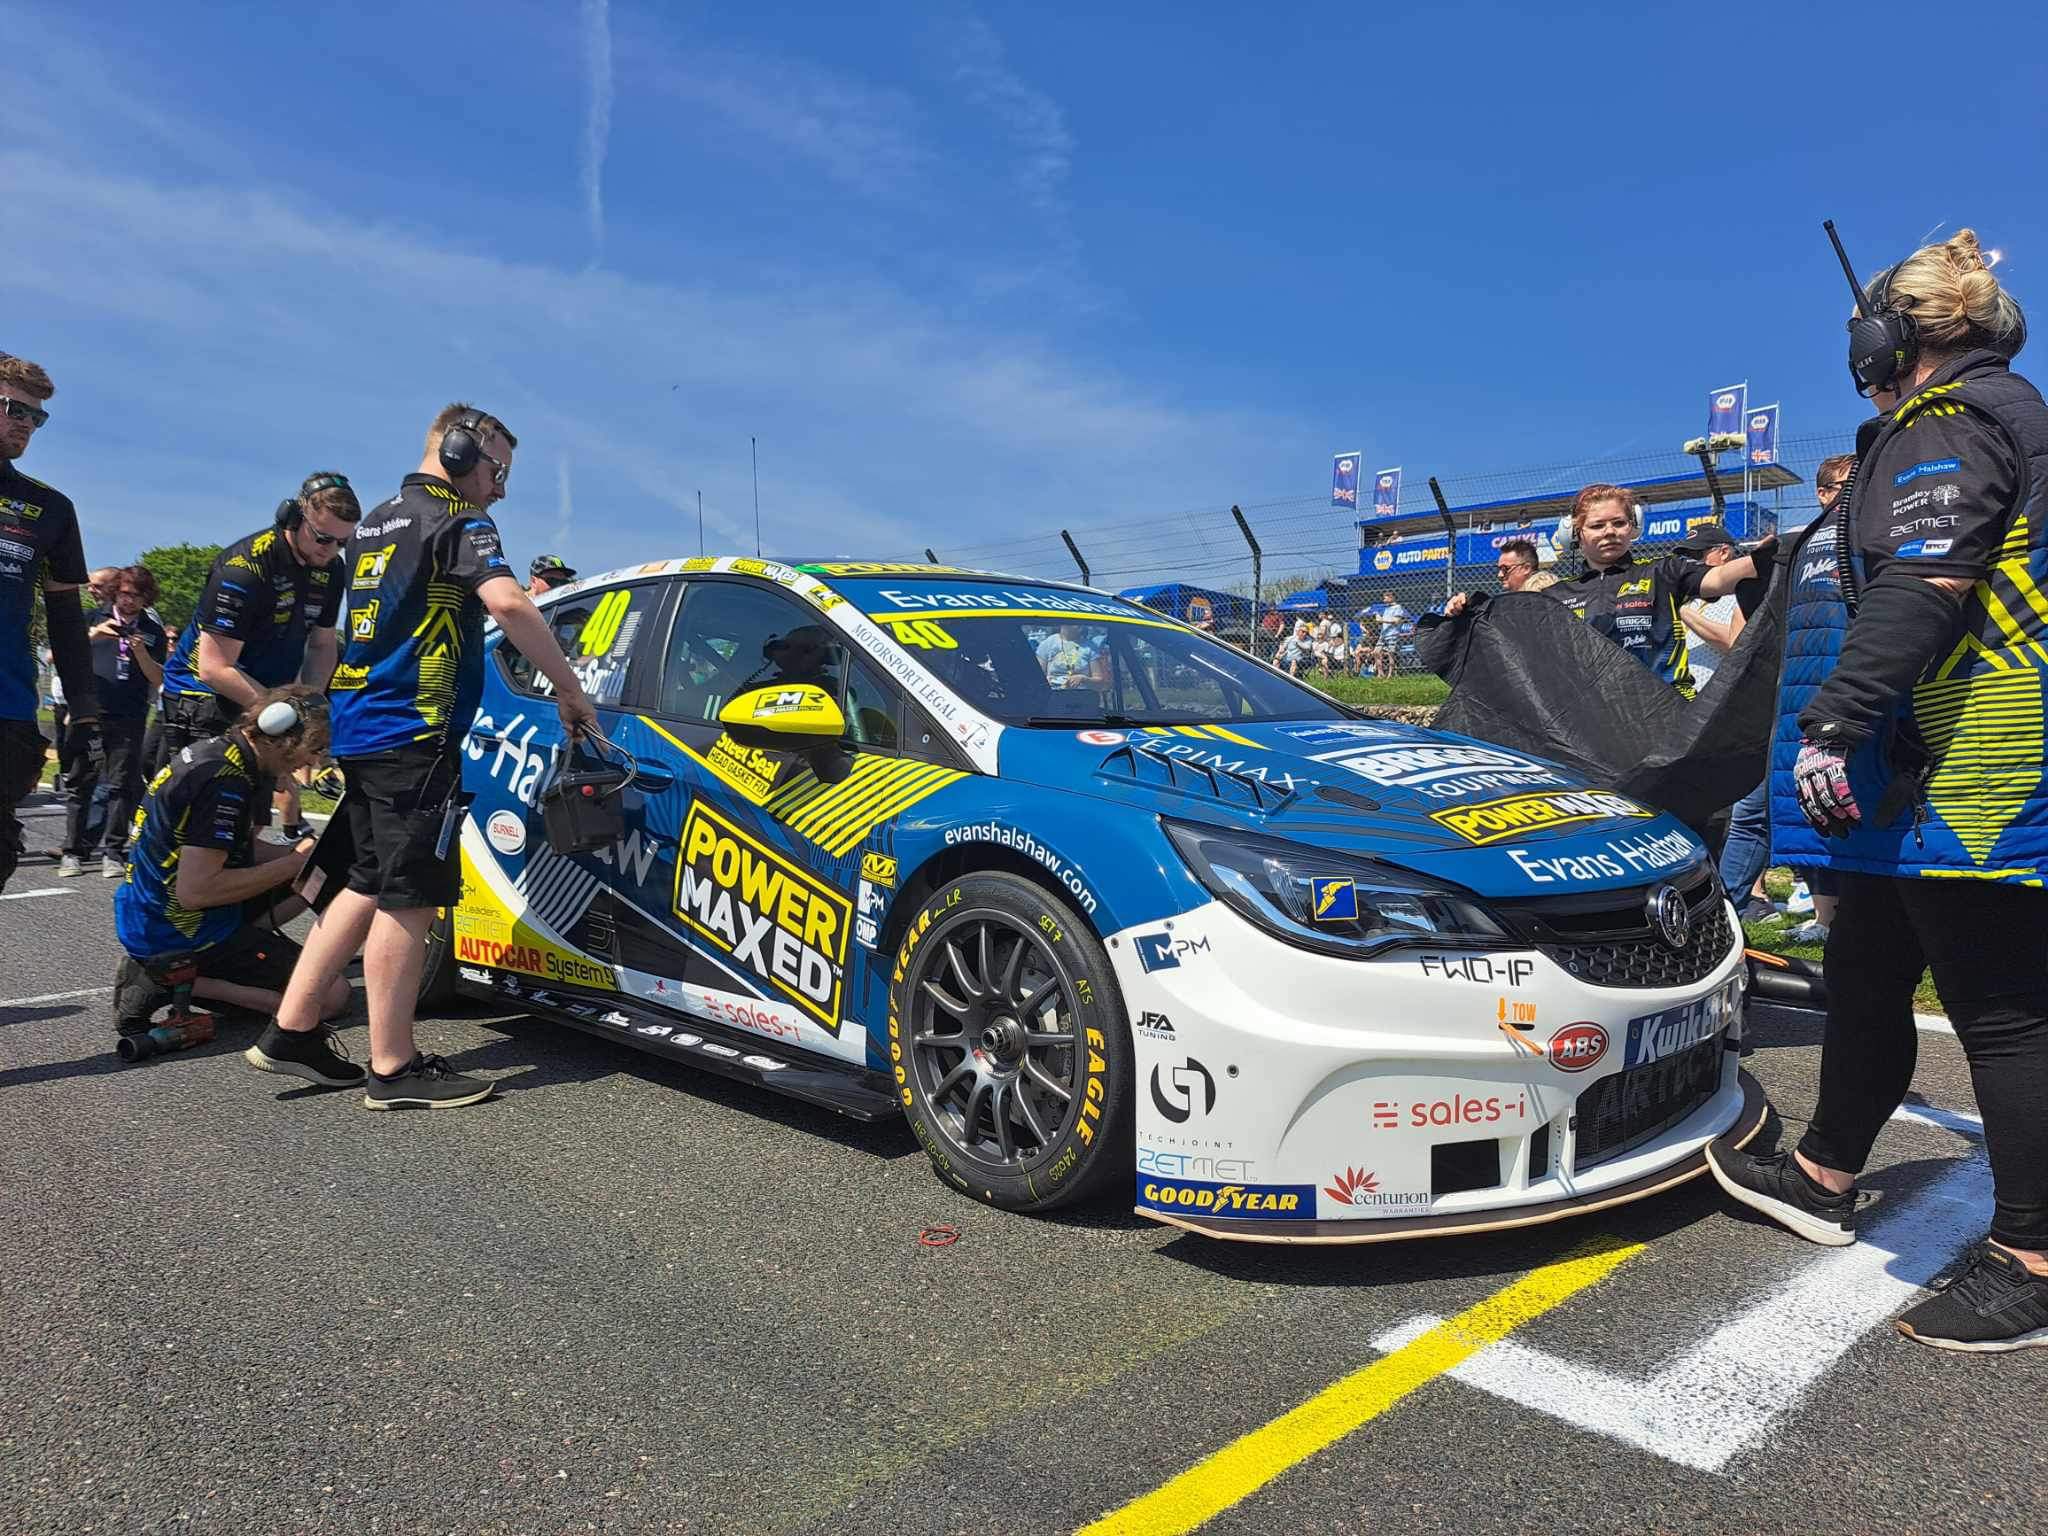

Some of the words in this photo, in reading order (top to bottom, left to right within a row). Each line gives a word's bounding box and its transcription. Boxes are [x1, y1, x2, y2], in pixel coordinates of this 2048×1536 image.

[1893, 490, 1931, 508] Bramley
[1893, 499, 1928, 516] POWER
[1648, 519, 1681, 536] AUTO
[1890, 515, 1959, 537] ZETMET
[1396, 550, 1422, 565] AUTO
[878, 590, 1009, 608] Evans
[1002, 592, 1145, 619] Halshaw
[579, 588, 631, 656] 40
[891, 619, 959, 649] 40
[852, 623, 924, 688] MOTORSPORT
[919, 683, 958, 721] LEGAL
[756, 692, 826, 709] PMR
[716, 731, 751, 763] Steel
[747, 748, 781, 782] Seal
[1140, 738, 1306, 791] EPIMAX
[1336, 749, 1515, 778] BRIGGS
[708, 748, 728, 769] HEAD
[727, 760, 754, 787] GASKET
[752, 779, 769, 797] FIX
[1412, 773, 1568, 798] EQUIPMENT
[1447, 799, 1562, 838] POWER
[1544, 792, 1641, 817] MAXED
[493, 822, 520, 838] BURNELL
[944, 821, 1098, 914] evanshalshaw.com
[1507, 849, 1625, 883] Evans
[1606, 830, 1696, 873] Halshaw
[686, 817, 837, 959] POWER
[680, 865, 832, 1003] MAXED
[1038, 913, 1056, 935] SET
[460, 936, 542, 973] AUTOCAR
[1155, 935, 1211, 961] MPM
[1076, 978, 1094, 1006] ATS
[723, 1002, 801, 1042] sales-i
[1136, 1011, 1175, 1032] JFA
[1512, 1002, 1537, 1022] TOW
[1138, 1029, 1176, 1042] TUNING
[1560, 1035, 1602, 1059] ABS
[1636, 1003, 1702, 1064] Kwik
[1076, 1026, 1106, 1150] EAGLE
[1410, 1093, 1525, 1127] sales-i
[1138, 1147, 1255, 1181] ZETMET
[1354, 1192, 1428, 1206] centurion
